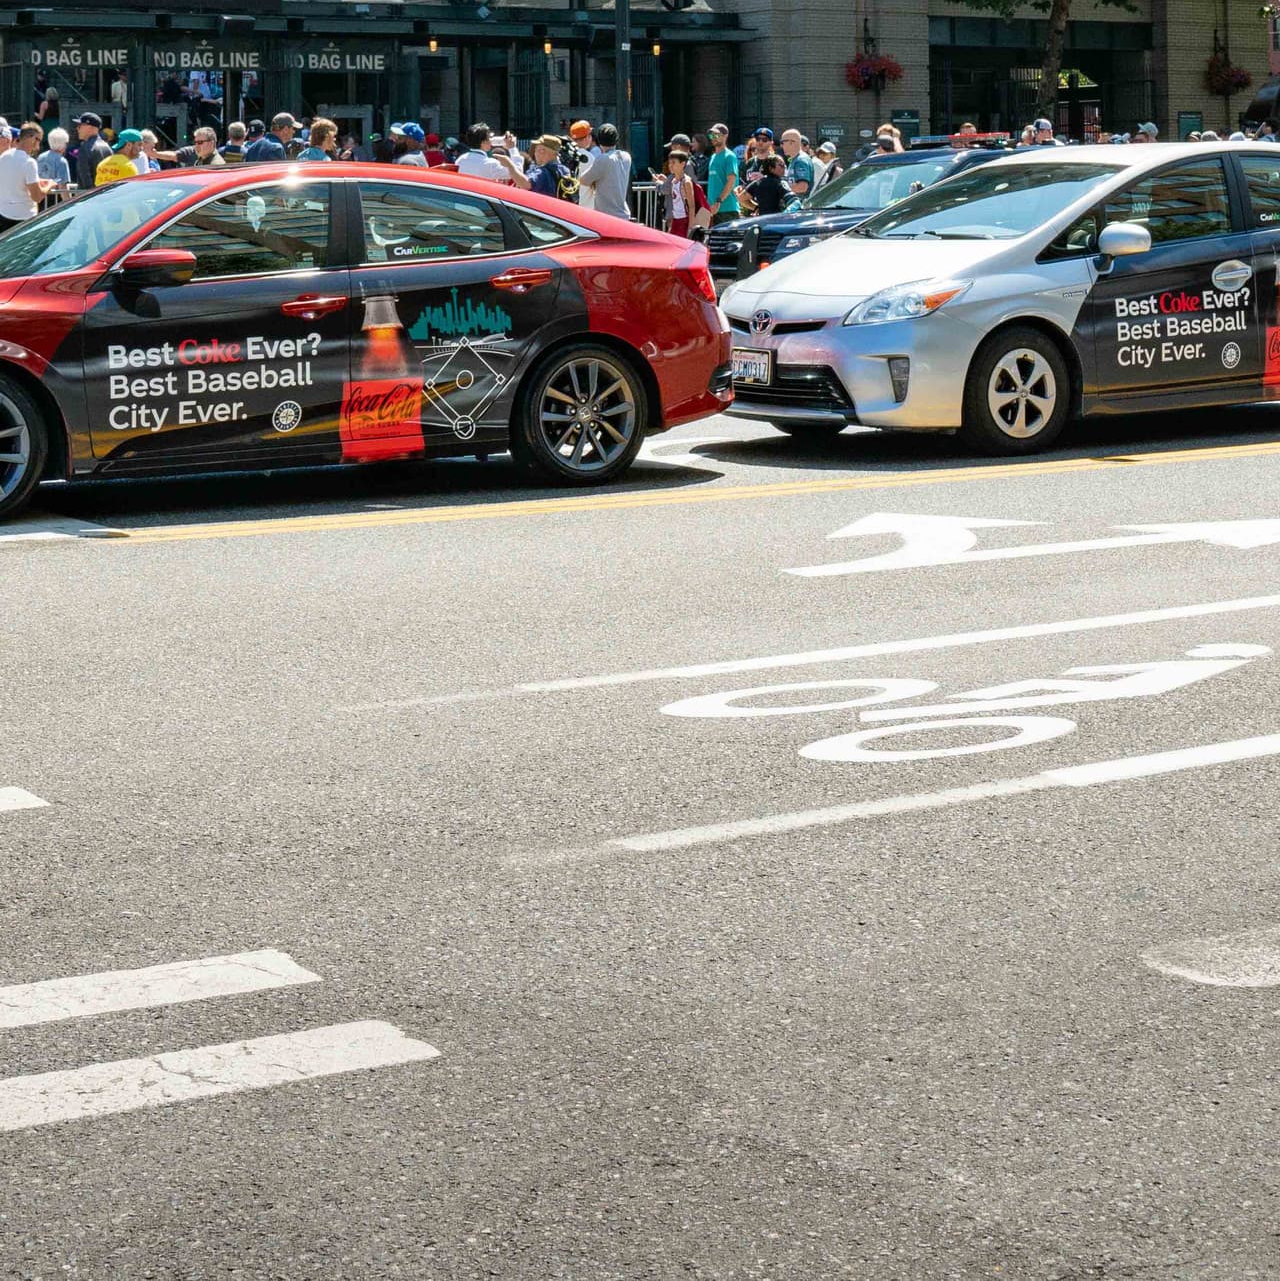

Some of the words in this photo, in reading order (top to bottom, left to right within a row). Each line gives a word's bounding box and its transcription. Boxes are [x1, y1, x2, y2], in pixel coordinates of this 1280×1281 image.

[46, 50, 82, 66] BAG
[87, 49, 128, 66] LINE
[154, 52, 176, 68] NO
[180, 52, 214, 68] BAG
[220, 52, 260, 68] LINE
[308, 54, 341, 69] BAG
[346, 54, 385, 70] LINE
[1115, 295, 1158, 317] Best
[1159, 292, 1201, 314] Coke
[1202, 287, 1251, 310] Ever?
[1117, 319, 1161, 342] Best
[1166, 310, 1247, 337] Baseball
[108, 342, 175, 369] Best
[178, 338, 243, 365] Coke
[246, 332, 321, 360] Ever?
[1117, 345, 1156, 368] City
[1161, 342, 1206, 362] Ever.
[109, 372, 178, 400] Best
[187, 361, 314, 394] Baseball
[109, 403, 169, 432] City
[179, 400, 248, 425] Ever.
